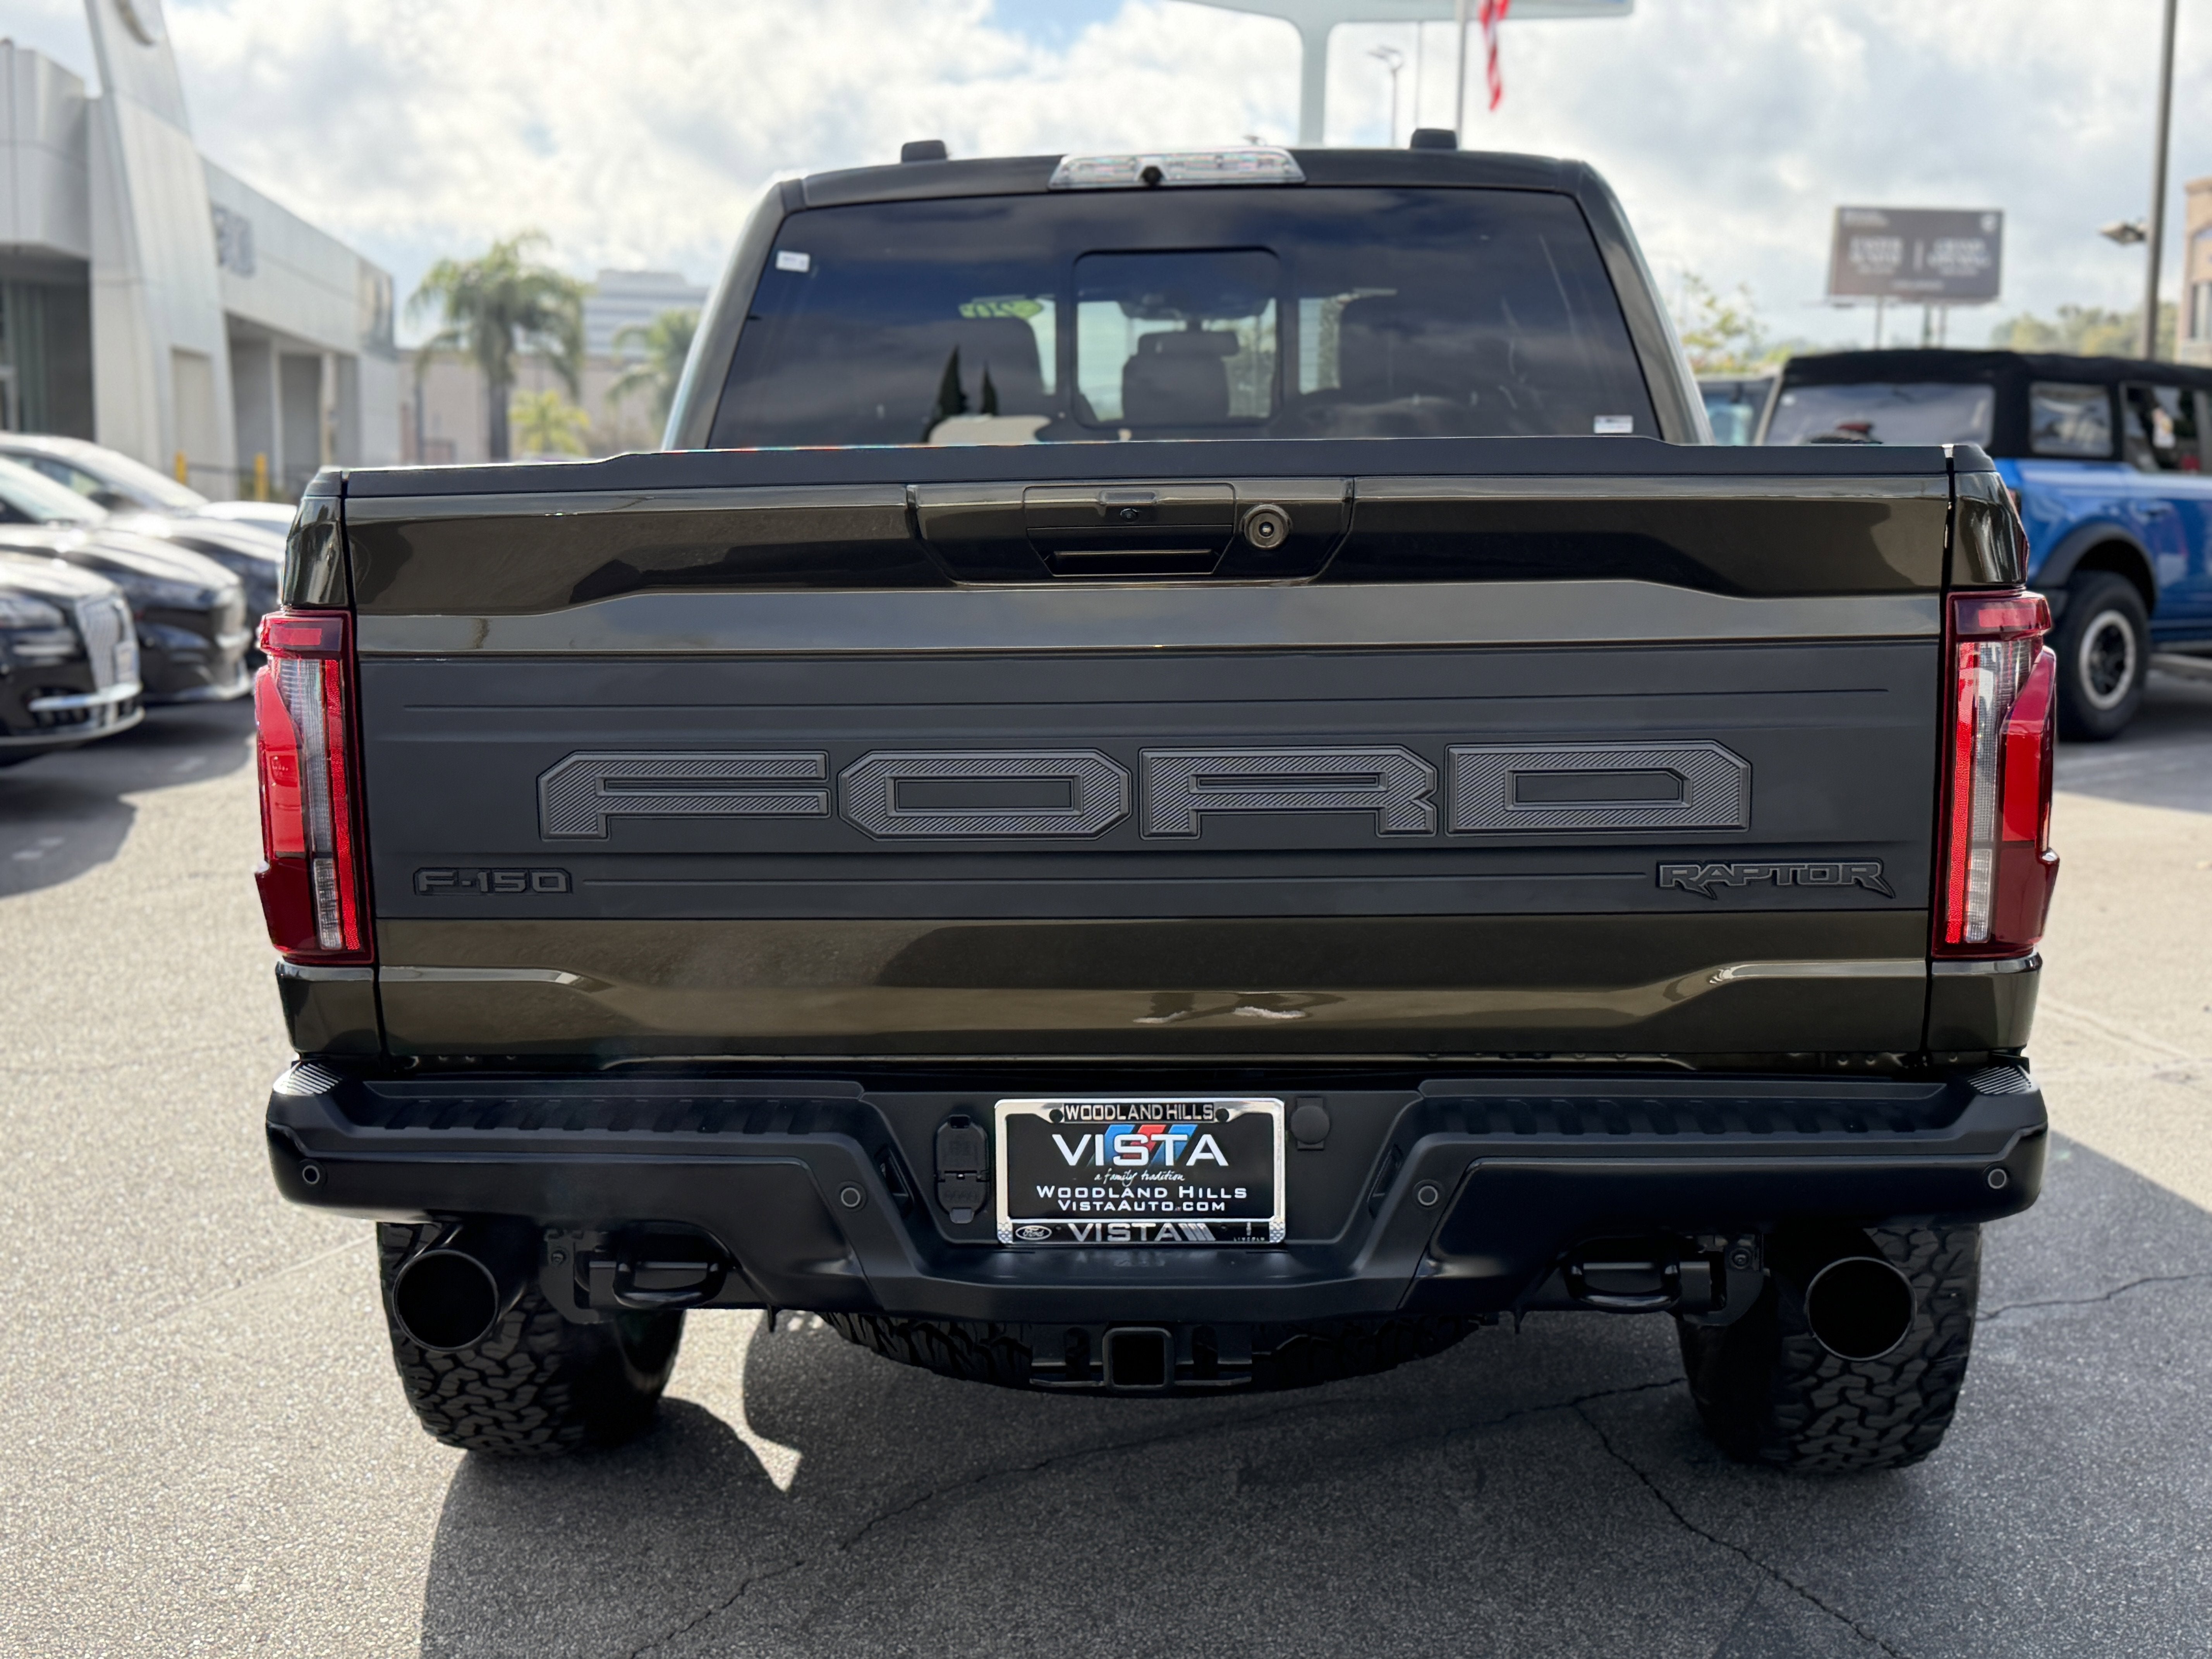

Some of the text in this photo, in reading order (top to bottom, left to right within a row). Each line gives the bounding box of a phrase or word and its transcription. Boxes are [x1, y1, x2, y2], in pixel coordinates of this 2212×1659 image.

[538, 739, 1753, 841] FORD
[414, 868, 572, 895] F-150
[1657, 859, 1895, 900] RAPTOR
[1066, 1104, 1213, 1120] WOODLAND HILLS
[1052, 1133, 1229, 1166] VISTA
[1103, 1168, 1138, 1187] family
[1141, 1169, 1186, 1181] tradition
[1036, 1185, 1248, 1199] WOODLAND HILLS
[1068, 1223, 1182, 1242] VISTA
